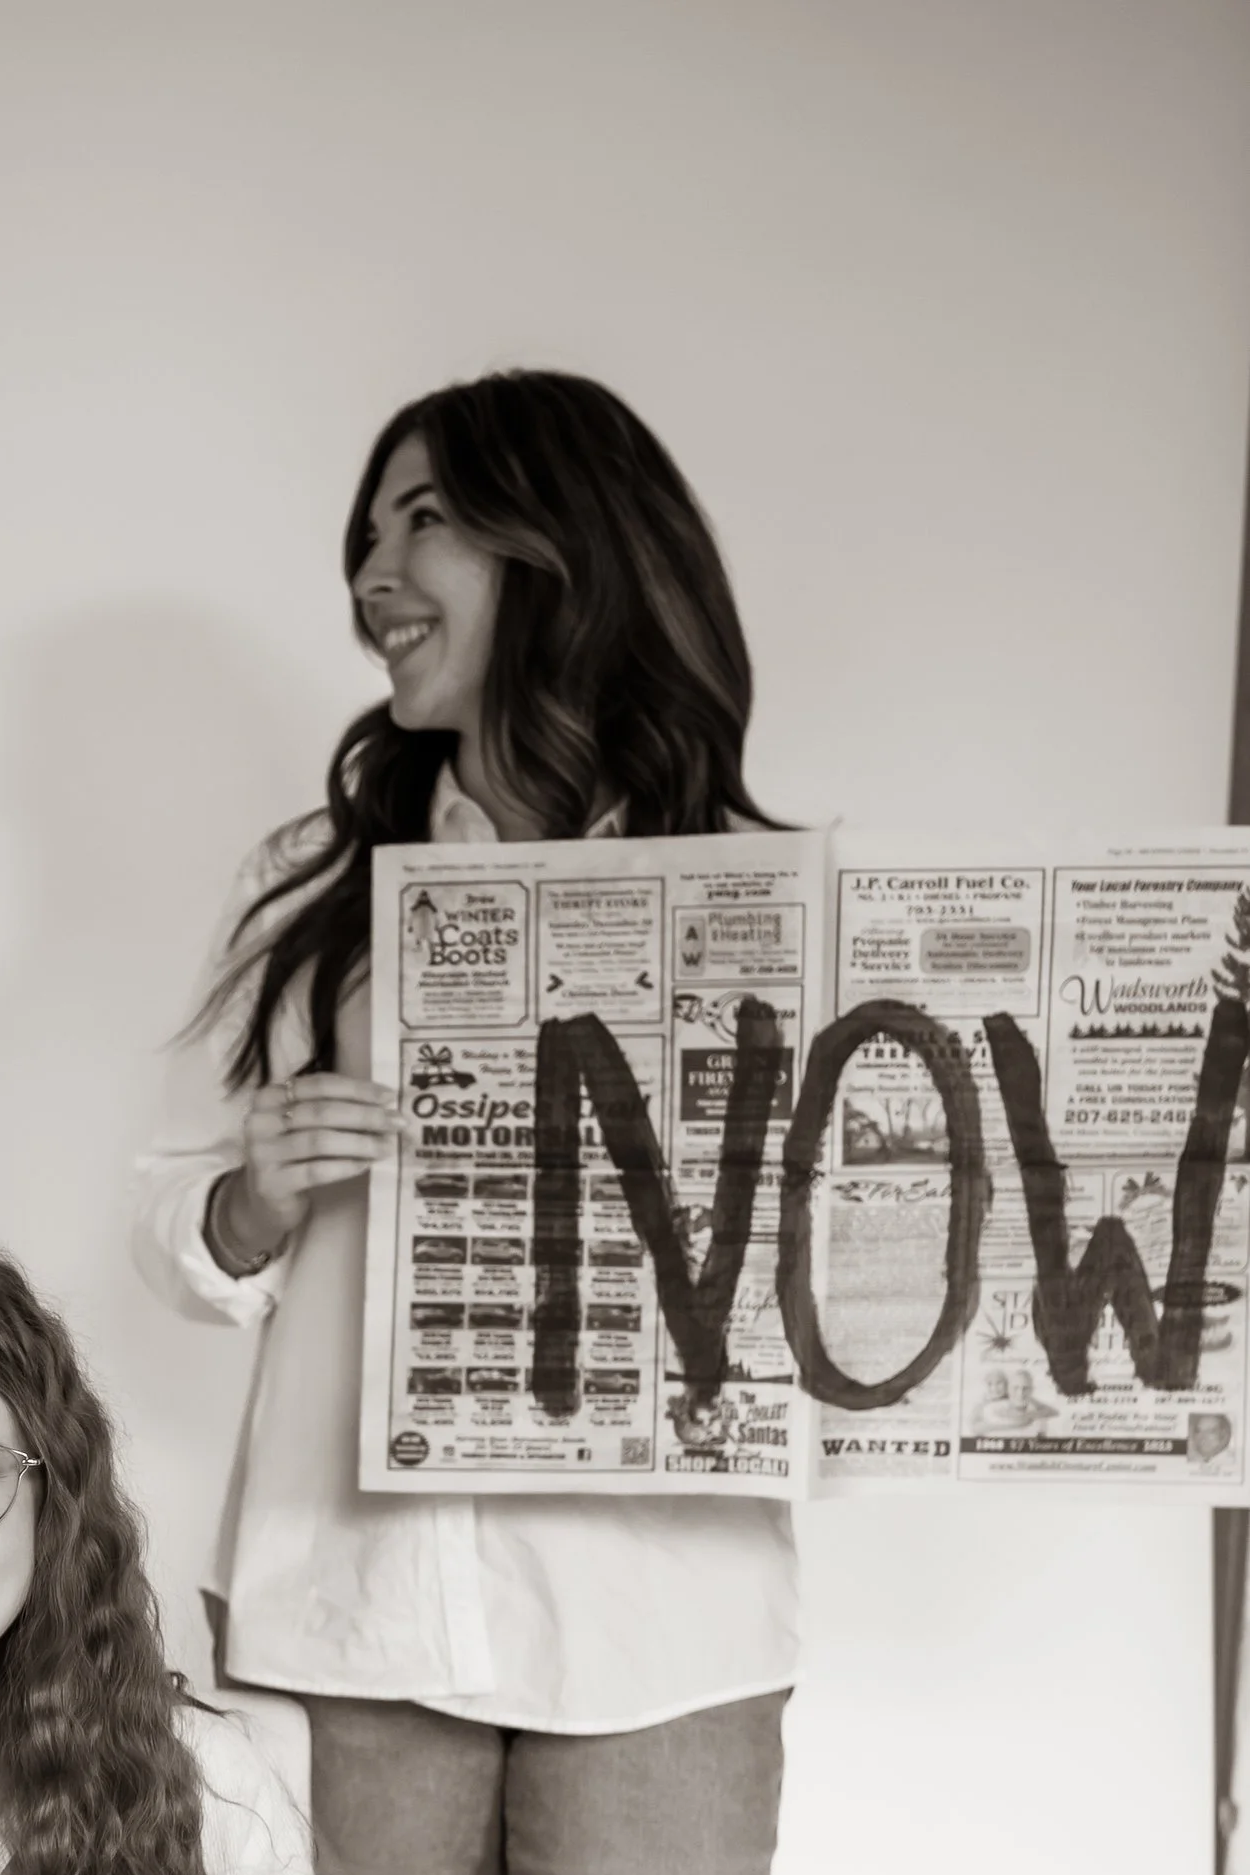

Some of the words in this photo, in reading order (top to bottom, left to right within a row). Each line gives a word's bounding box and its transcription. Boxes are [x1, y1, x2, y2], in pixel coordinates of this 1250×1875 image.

[851, 877, 882, 891] J.P.
[886, 876, 949, 890] Carroll
[955, 875, 994, 889] Fuel
[999, 875, 1031, 889] Co.
[1099, 880, 1132, 892] Local
[1133, 880, 1185, 893] Forestry
[1186, 880, 1244, 892] Company
[445, 907, 516, 923] WINTER
[709, 912, 782, 928] Plumbing
[436, 923, 519, 947] Coats
[685, 925, 699, 940] A
[851, 936, 911, 950] Propane
[428, 942, 509, 966] Boots
[681, 952, 703, 968] W
[852, 949, 910, 961] Delivery
[861, 961, 912, 972] Service
[1059, 974, 1209, 1015] Wadsworth
[1113, 1002, 1208, 1014] WOODLANDS
[412, 1092, 536, 1129] Ossipe
[904, 1178, 951, 1203] Sal
[533, 995, 1250, 1419] NOW
[737, 1422, 788, 1446] Santas
[822, 1438, 951, 1457] WANTED
[665, 1455, 717, 1472] SHOP
[728, 1456, 789, 1477] LOCAL!
